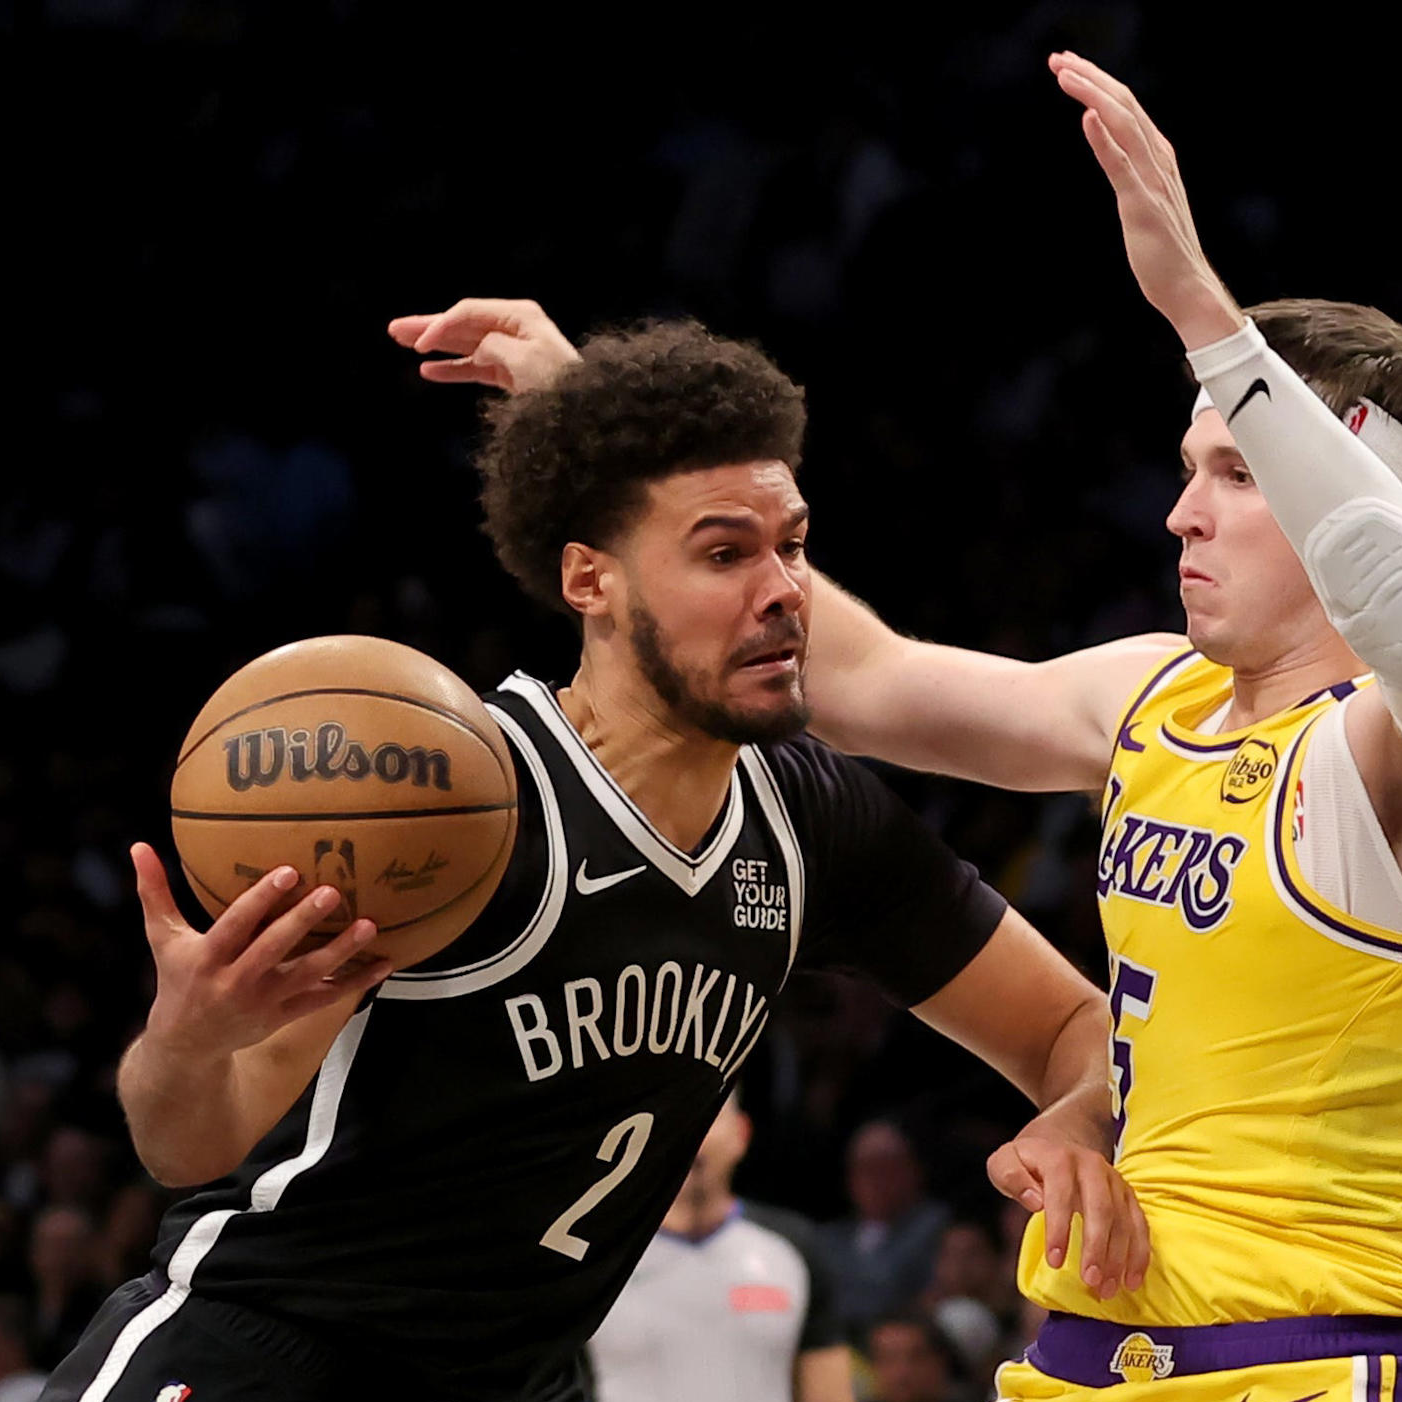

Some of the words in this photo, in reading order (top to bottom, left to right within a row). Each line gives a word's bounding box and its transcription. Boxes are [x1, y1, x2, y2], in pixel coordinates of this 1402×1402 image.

[224, 720, 452, 792] Wilson
[732, 858, 768, 882] GET
[733, 881, 786, 908] YOUR
[733, 904, 787, 931] GUIDE
[539, 1112, 654, 1262] 2
[1112, 1346, 1174, 1376] LAKERS
